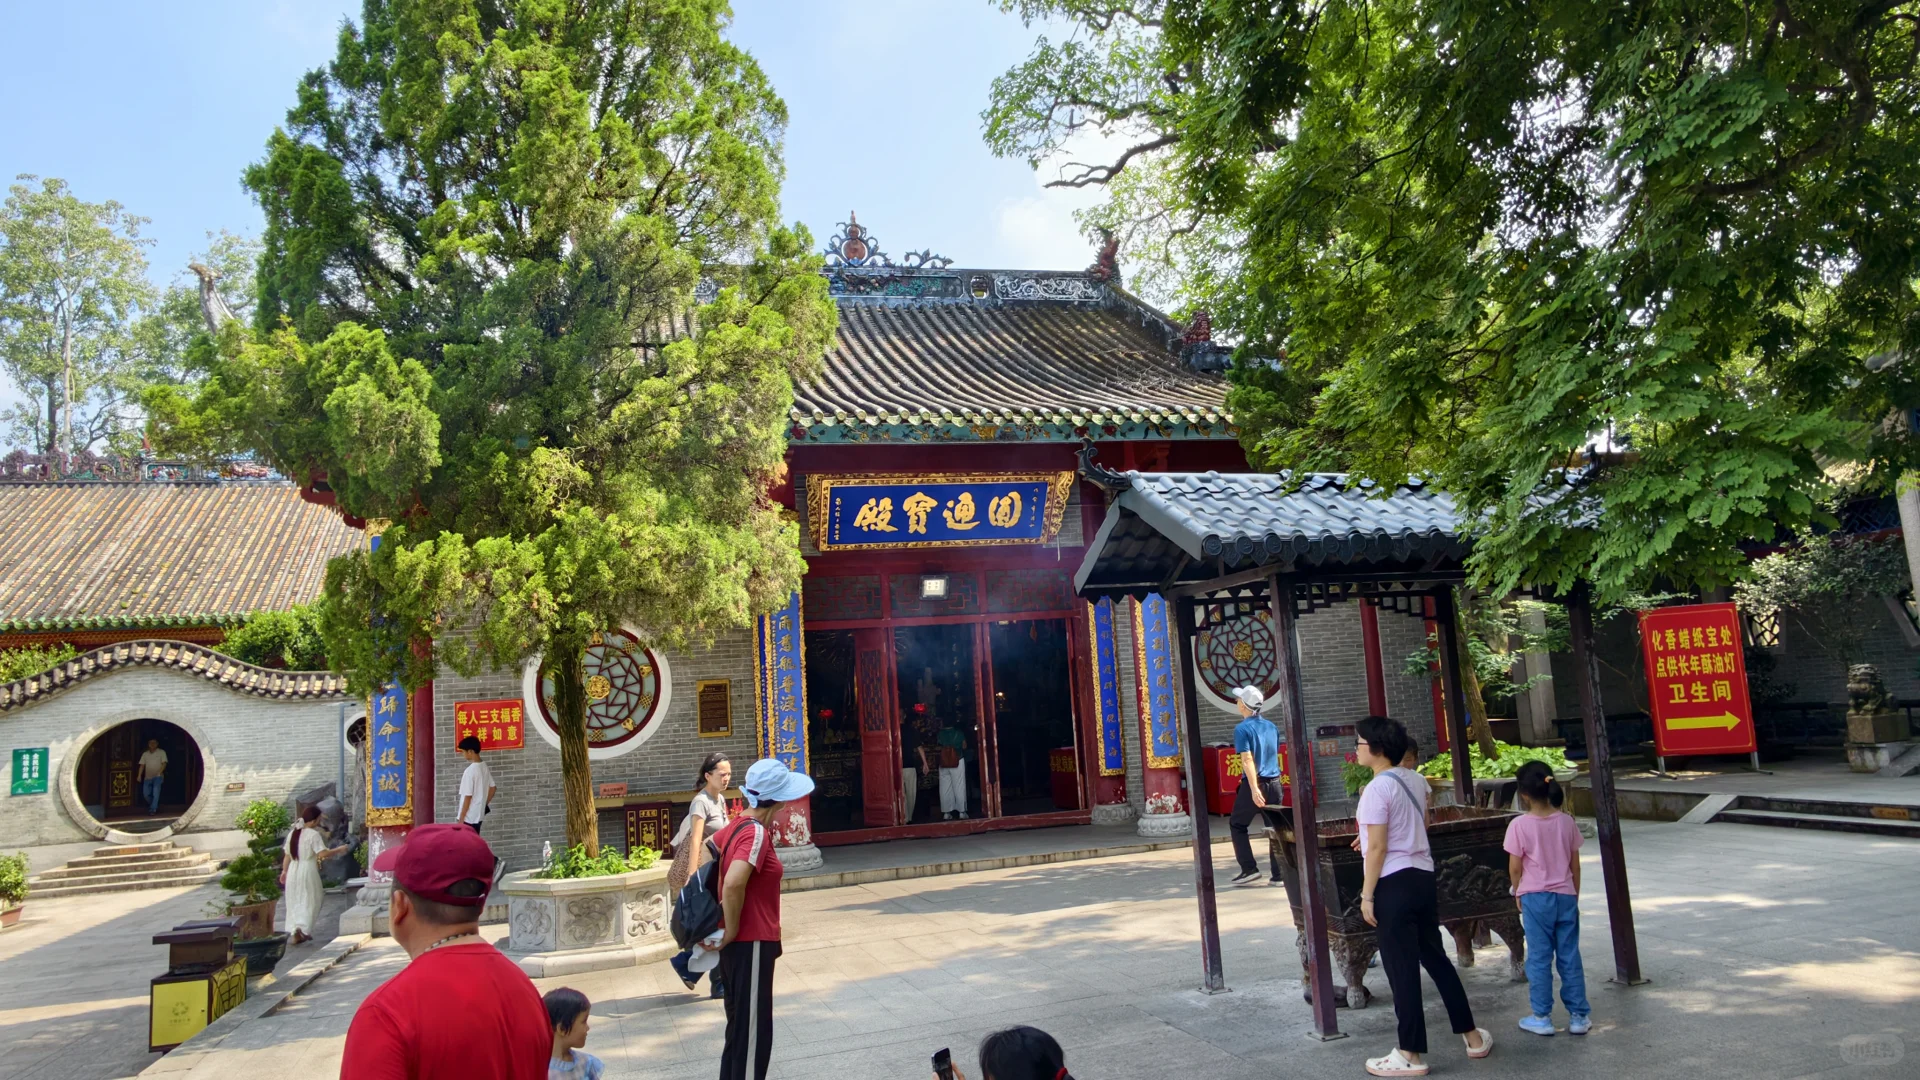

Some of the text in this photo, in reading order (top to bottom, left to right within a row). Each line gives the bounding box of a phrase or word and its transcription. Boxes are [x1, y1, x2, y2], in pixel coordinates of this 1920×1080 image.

[1652, 625, 1733, 651] 化香蜡纸宝处
[1656, 652, 1735, 678] 点供长年酥油灯
[1669, 680, 1732, 704] 卫生间
[457, 707, 521, 726] 每人三支福香
[462, 725, 517, 742] 吉祥如意
